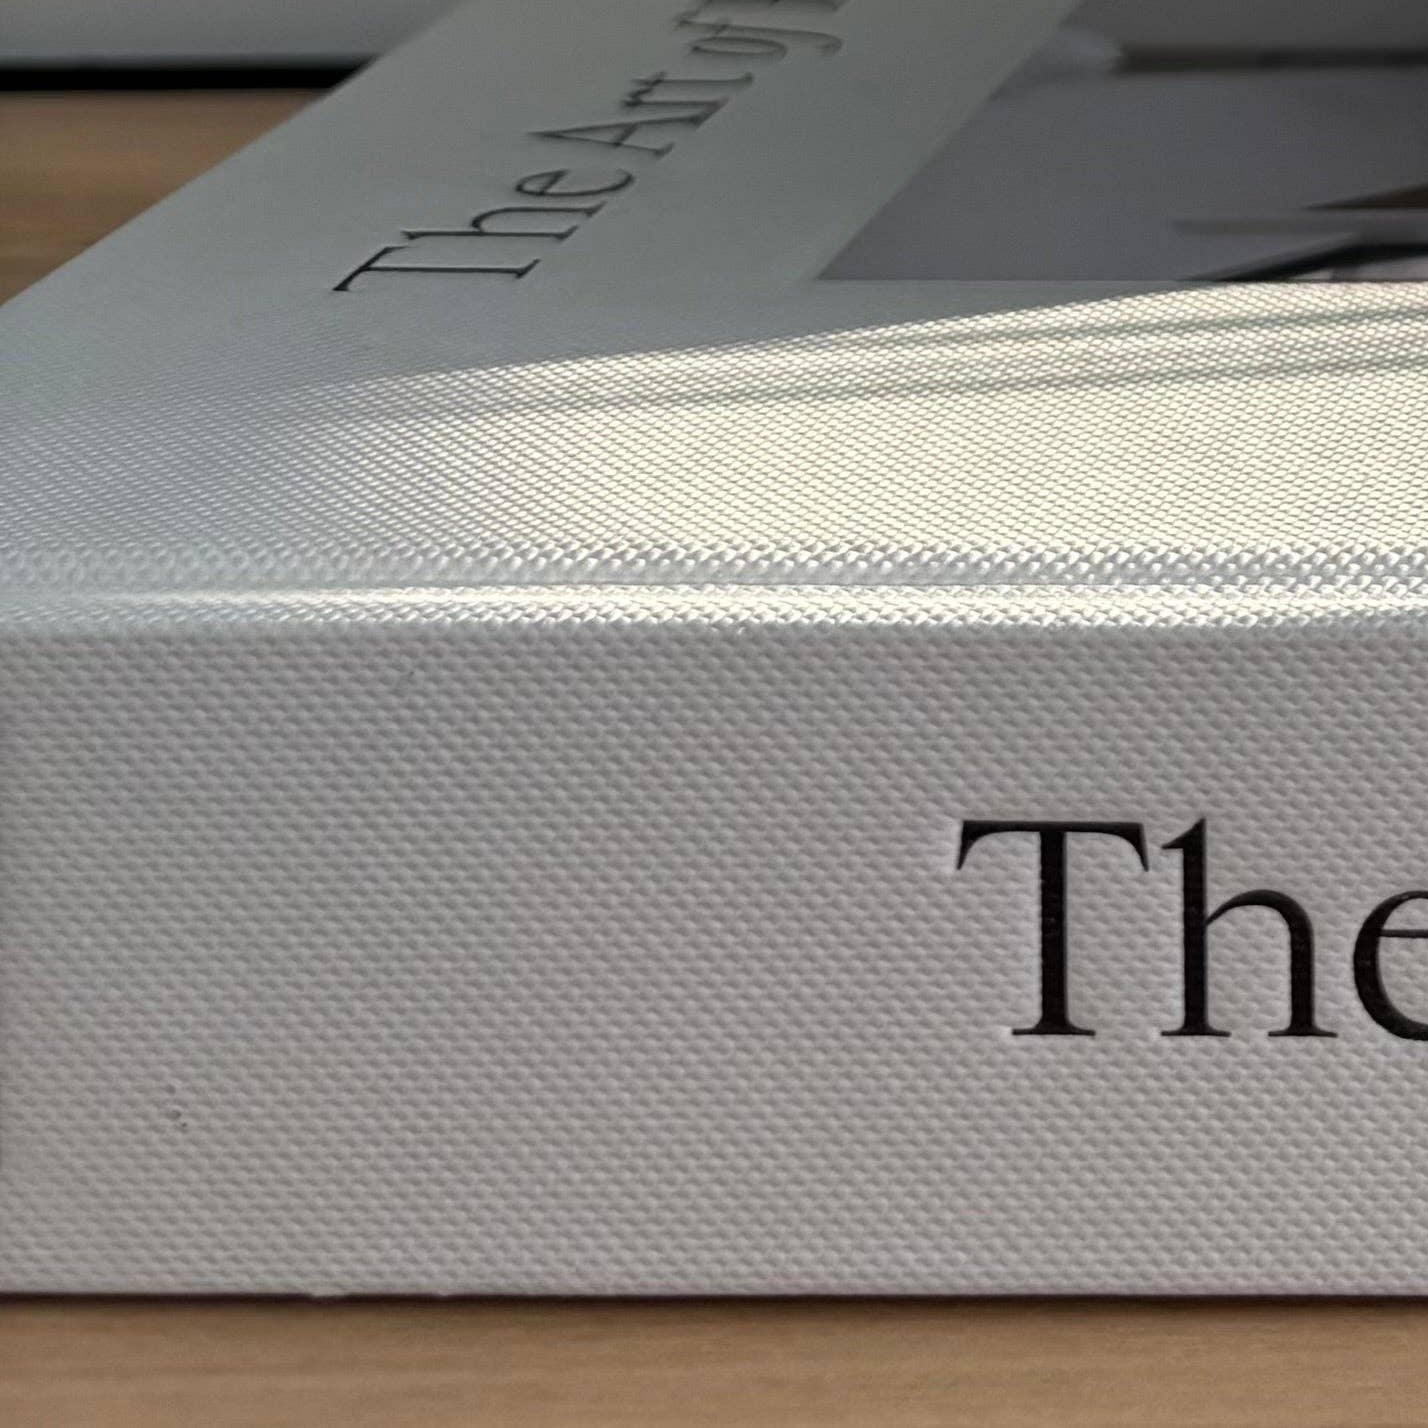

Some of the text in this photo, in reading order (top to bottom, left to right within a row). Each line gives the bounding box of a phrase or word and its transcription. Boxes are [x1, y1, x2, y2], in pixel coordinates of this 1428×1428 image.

[332, 169, 634, 292] The
[527, 71, 754, 158] Art
[671, 6, 843, 58] of
